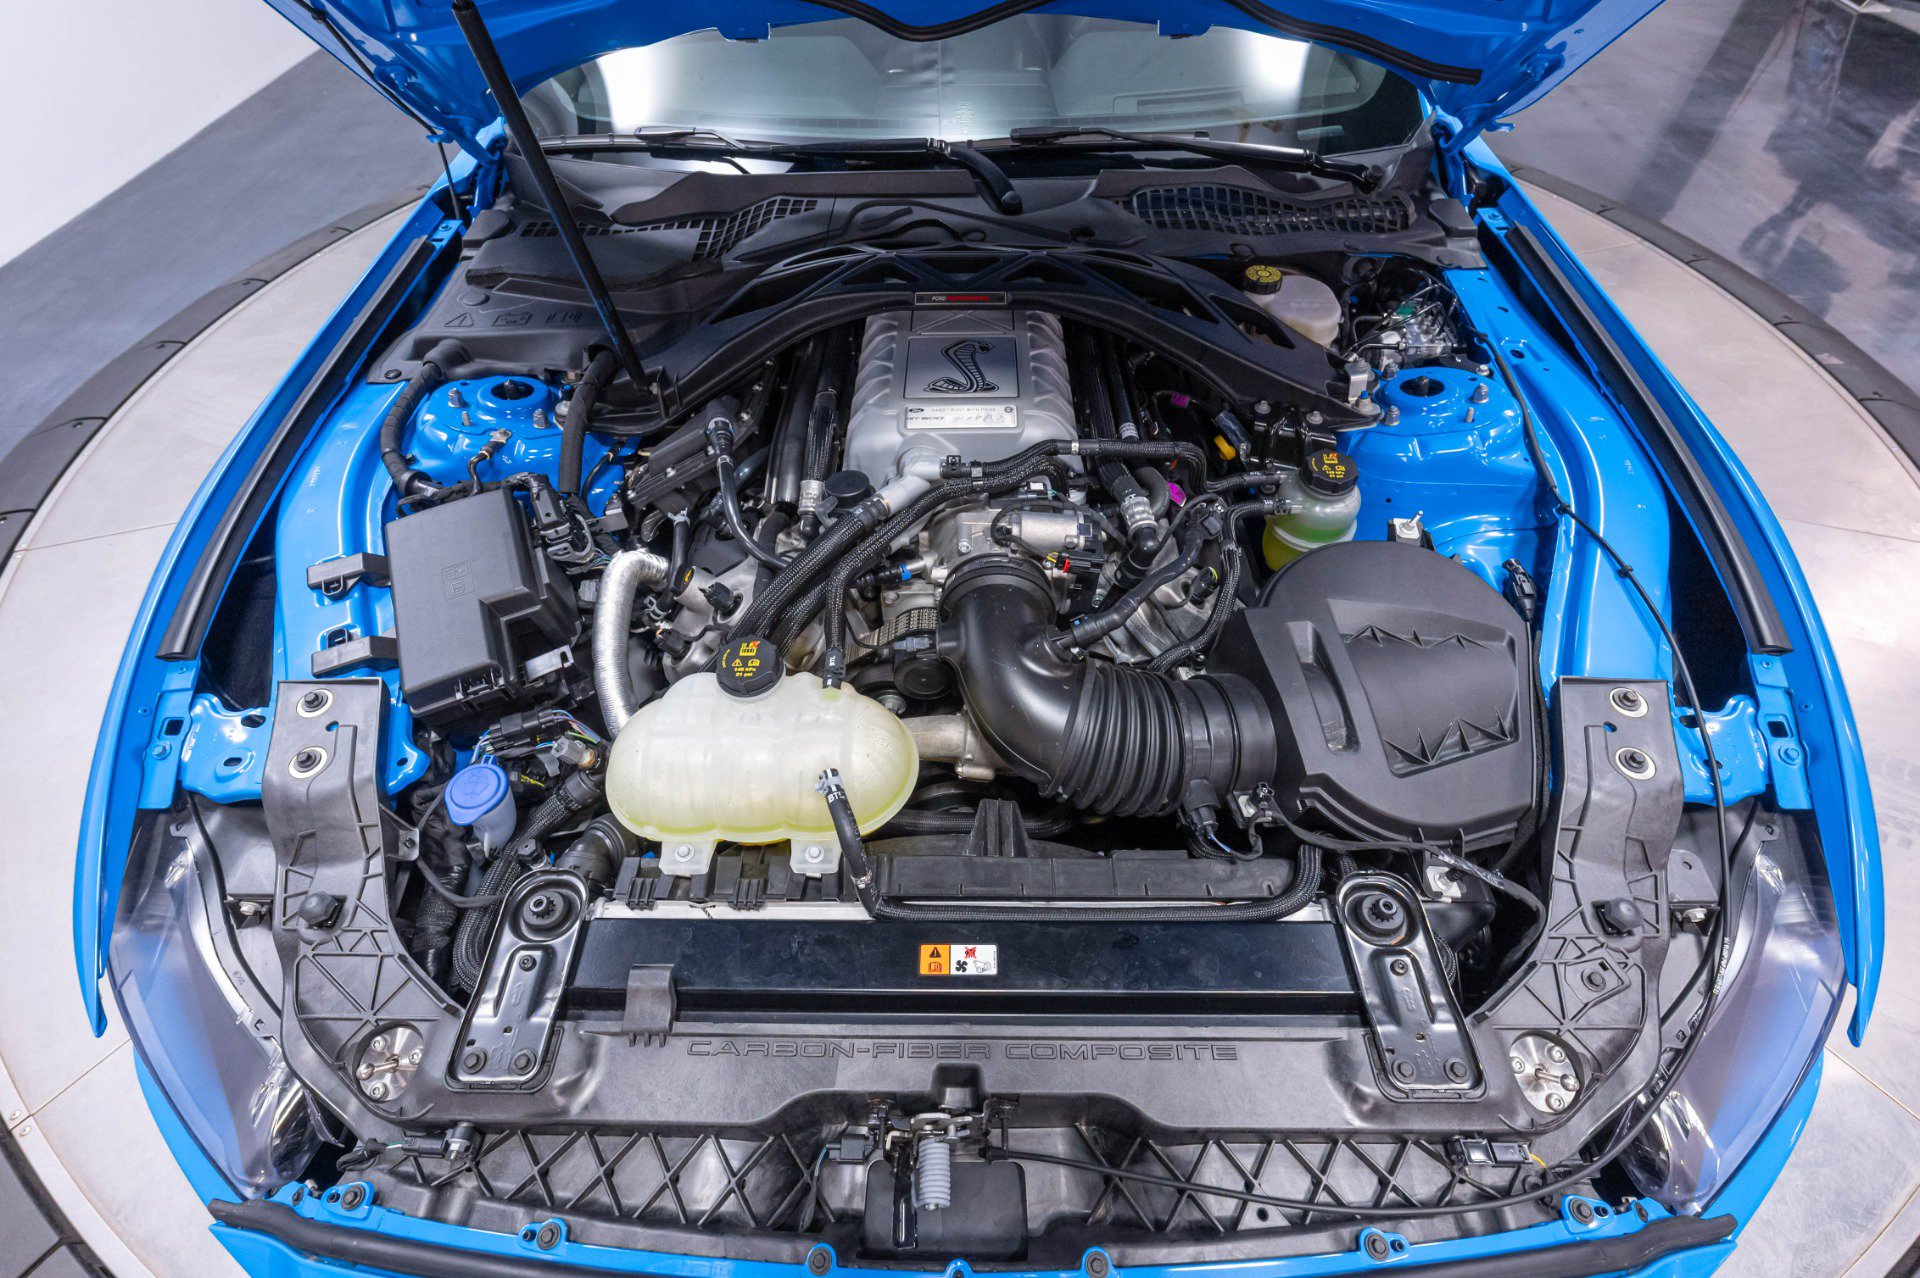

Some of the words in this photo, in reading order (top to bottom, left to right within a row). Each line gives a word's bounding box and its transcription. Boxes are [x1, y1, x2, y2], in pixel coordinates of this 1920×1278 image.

[828, 791, 845, 804] BTL
[687, 1041, 990, 1059] CARBON-FIBER
[1005, 1043, 1238, 1061] COMPOSITE
